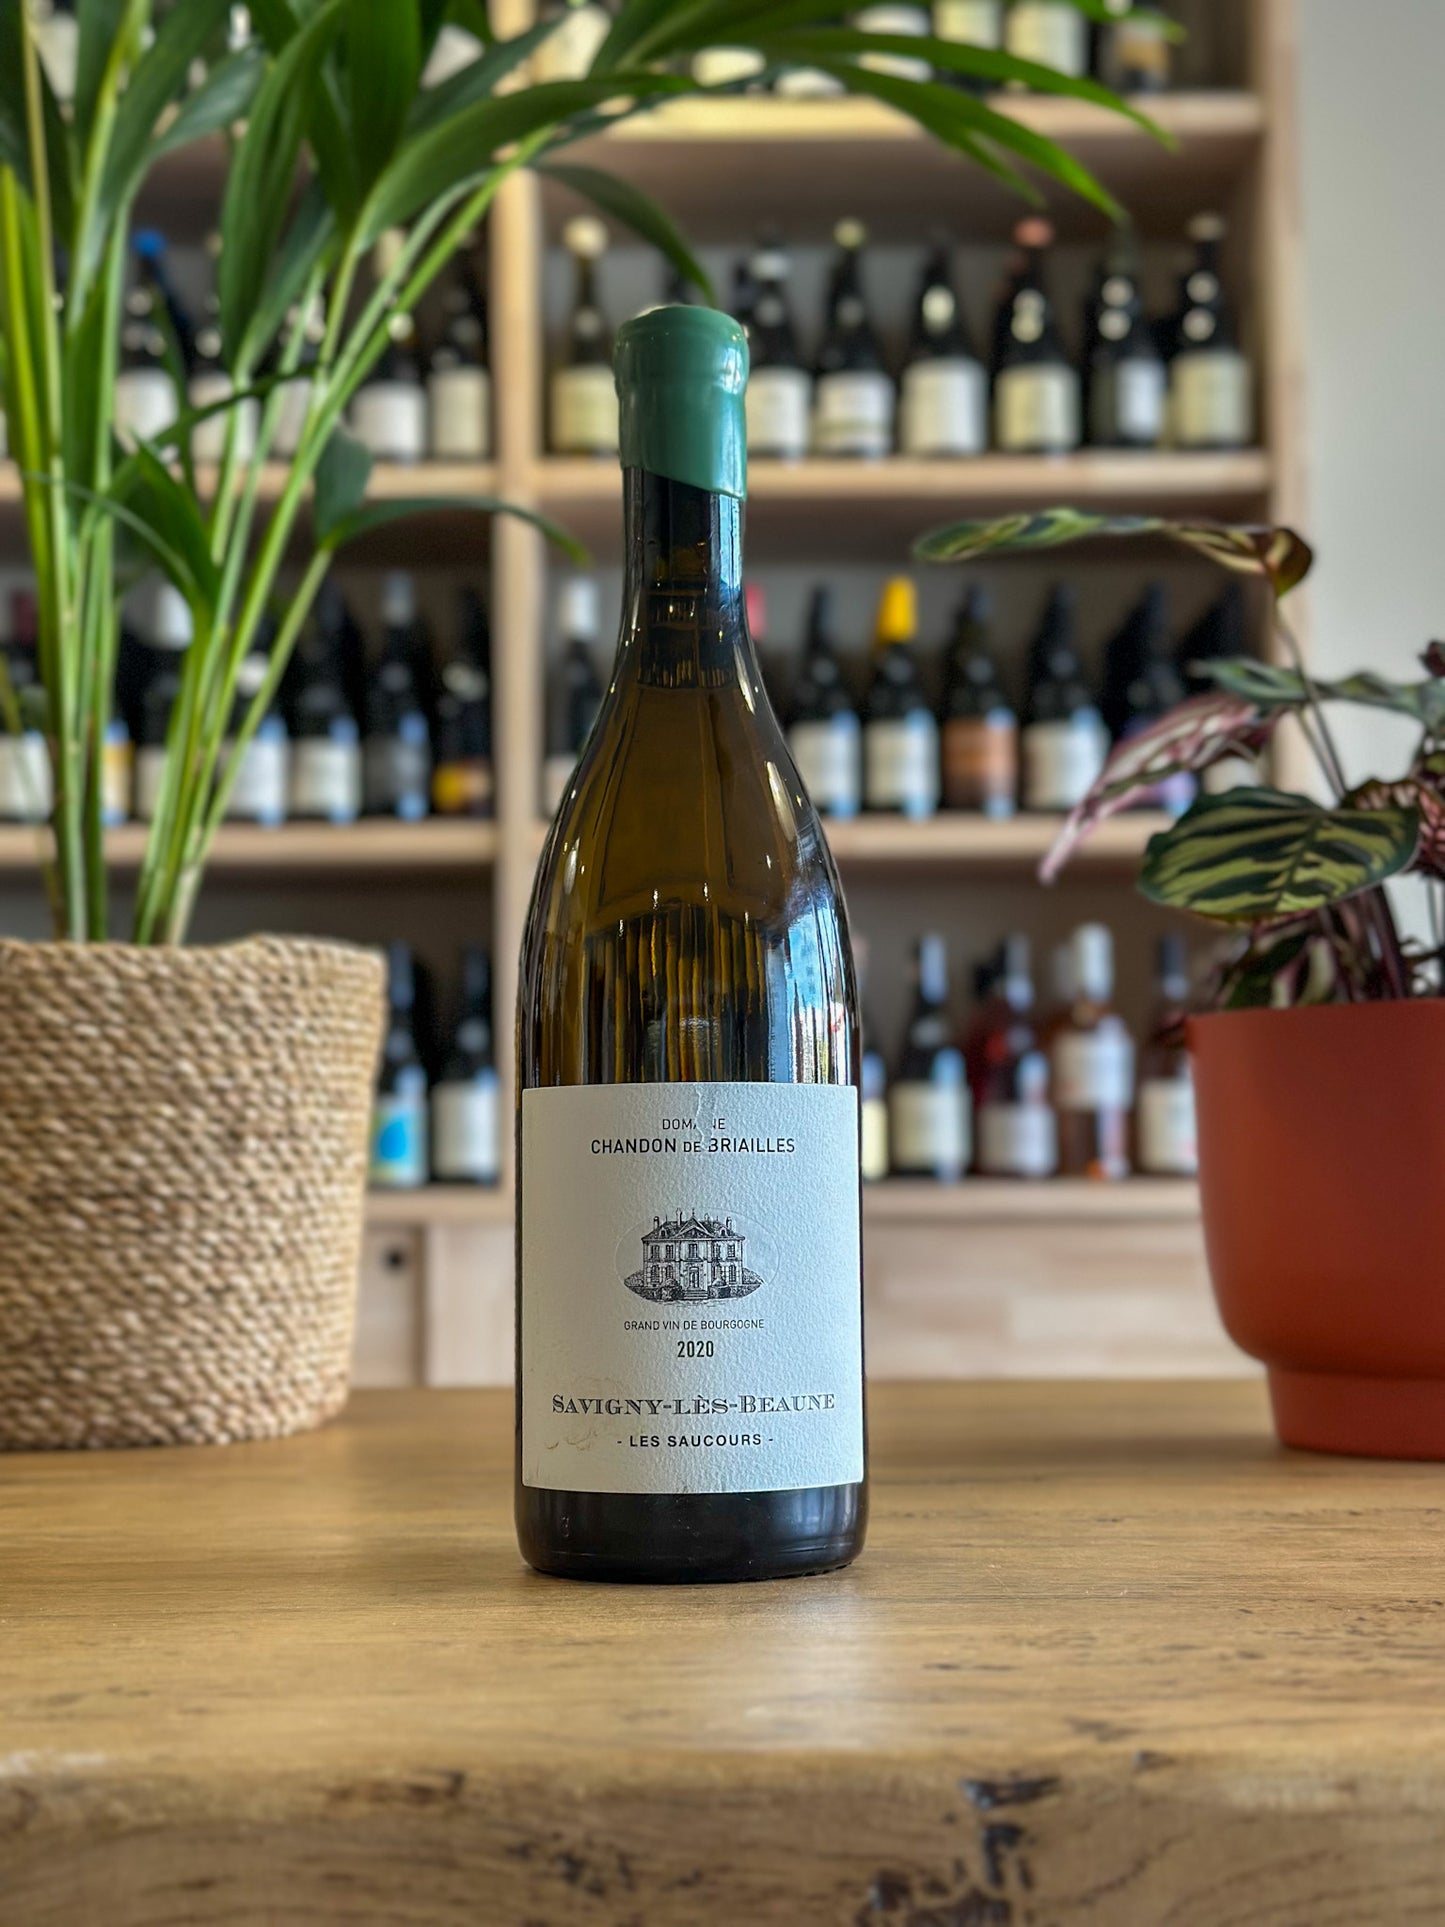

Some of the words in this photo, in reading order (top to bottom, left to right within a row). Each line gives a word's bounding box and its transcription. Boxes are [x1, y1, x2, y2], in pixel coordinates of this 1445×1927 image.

[662, 1118, 726, 1130] DOMNE
[591, 1138, 676, 1154] CHANDON
[683, 1141, 701, 1152] DE
[708, 1137, 795, 1153] BRIAILLES
[623, 1321, 660, 1331] GRAND
[663, 1320, 680, 1330] VIN
[683, 1320, 698, 1330] DE
[701, 1319, 764, 1330] BOURGOGNE
[677, 1340, 714, 1358] 2020
[629, 1435, 660, 1447] LES
[667, 1433, 762, 1447] SAUCOURS
